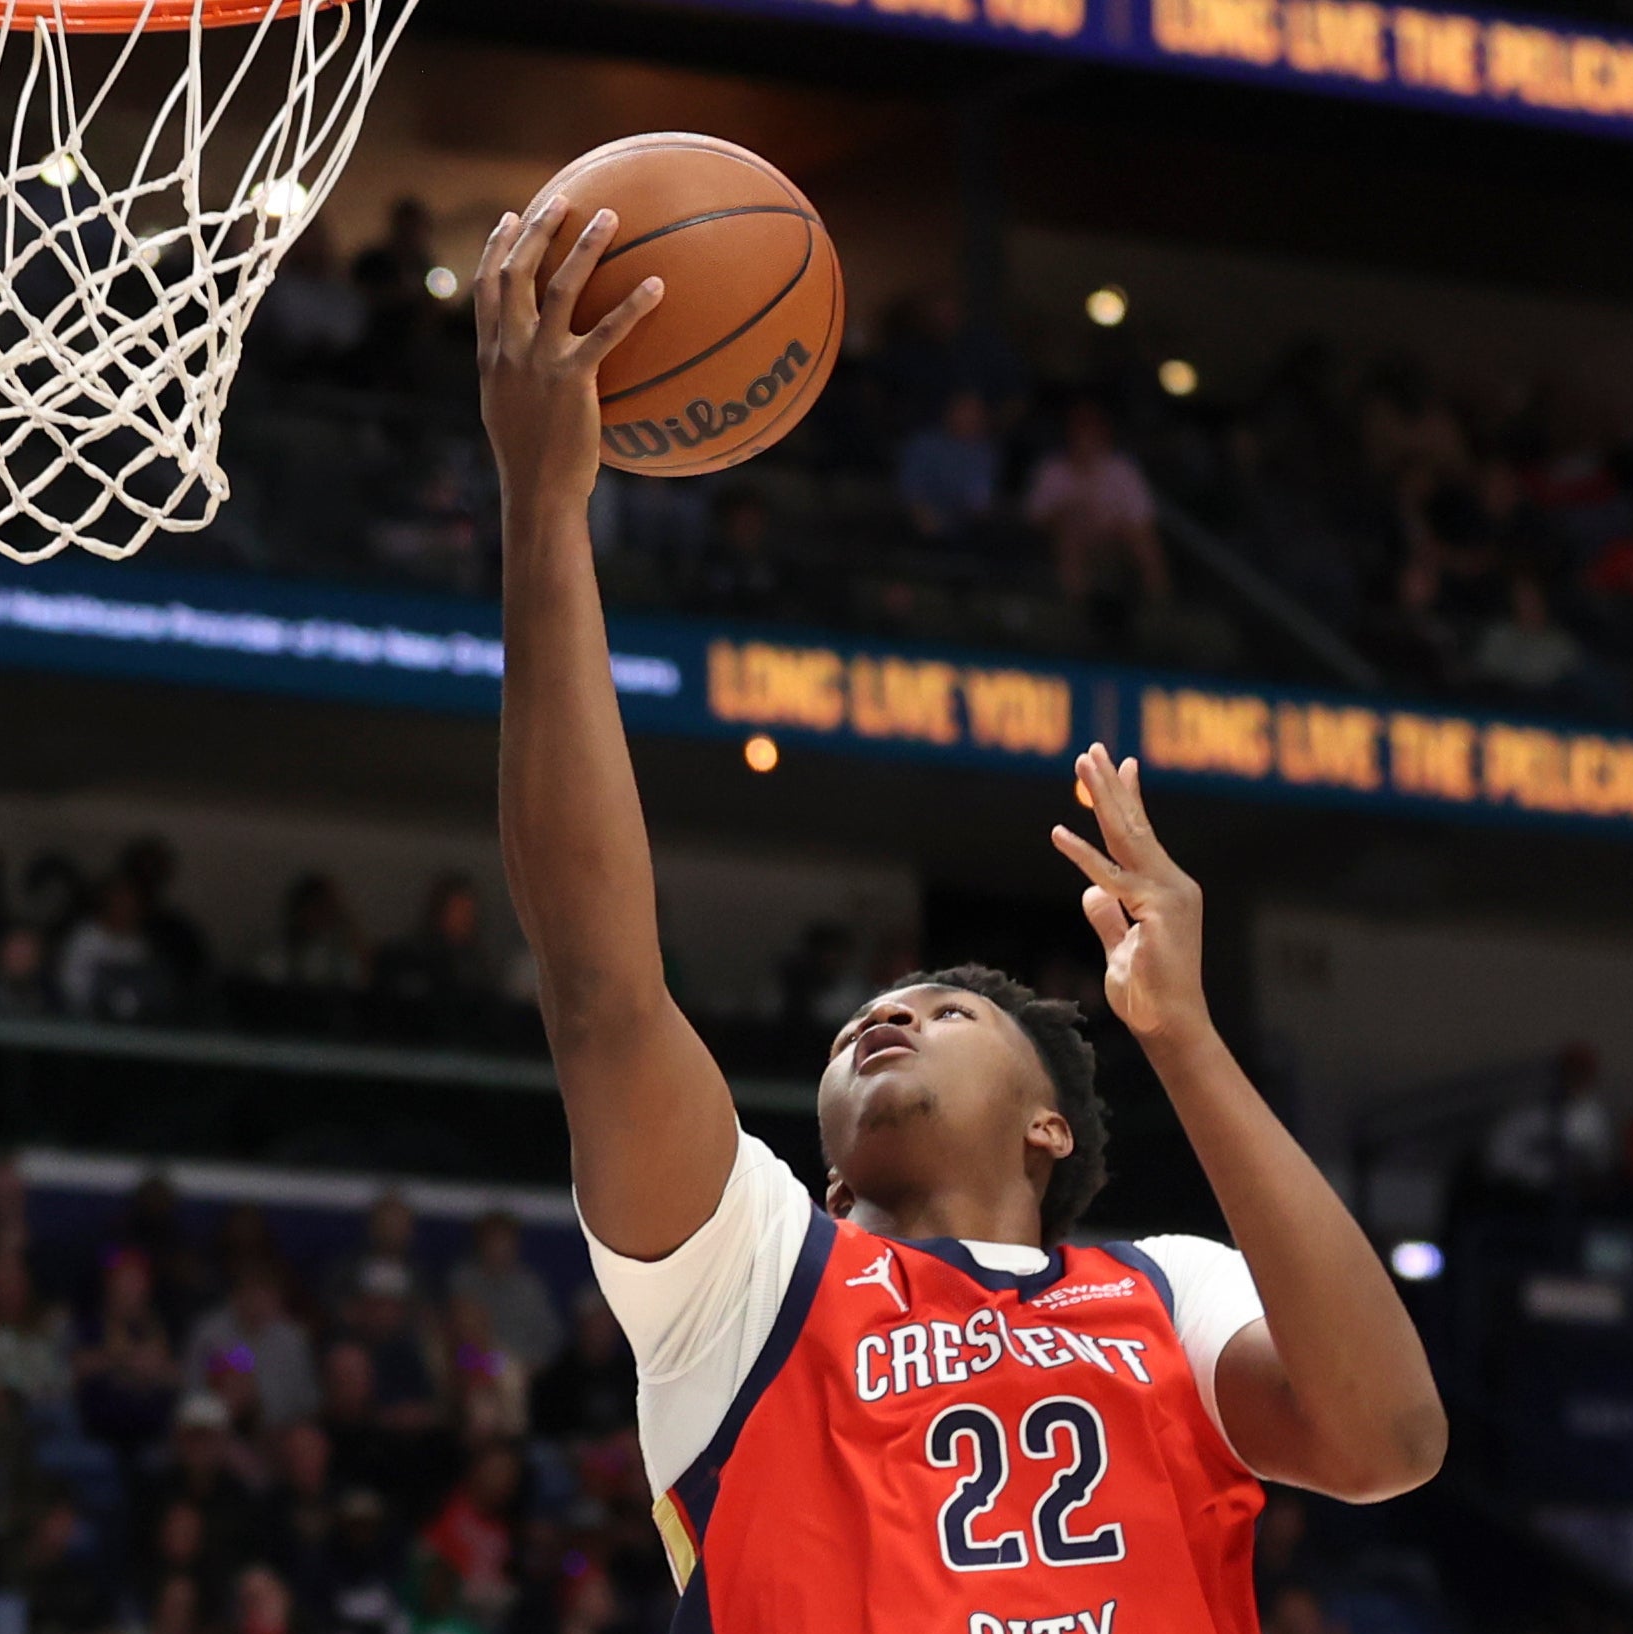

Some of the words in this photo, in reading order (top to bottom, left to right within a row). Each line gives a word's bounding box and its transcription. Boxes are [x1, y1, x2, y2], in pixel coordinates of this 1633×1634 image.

[1392, 3, 1483, 97] THE
[602, 338, 812, 460] Wilson
[707, 638, 846, 733] LONG
[848, 652, 960, 745] LIVE
[966, 664, 1072, 757] YOU
[1141, 686, 1272, 780] LONG
[1275, 700, 1383, 792] LIVE
[1387, 710, 1478, 803] THE
[924, 1394, 1126, 1573] 22
